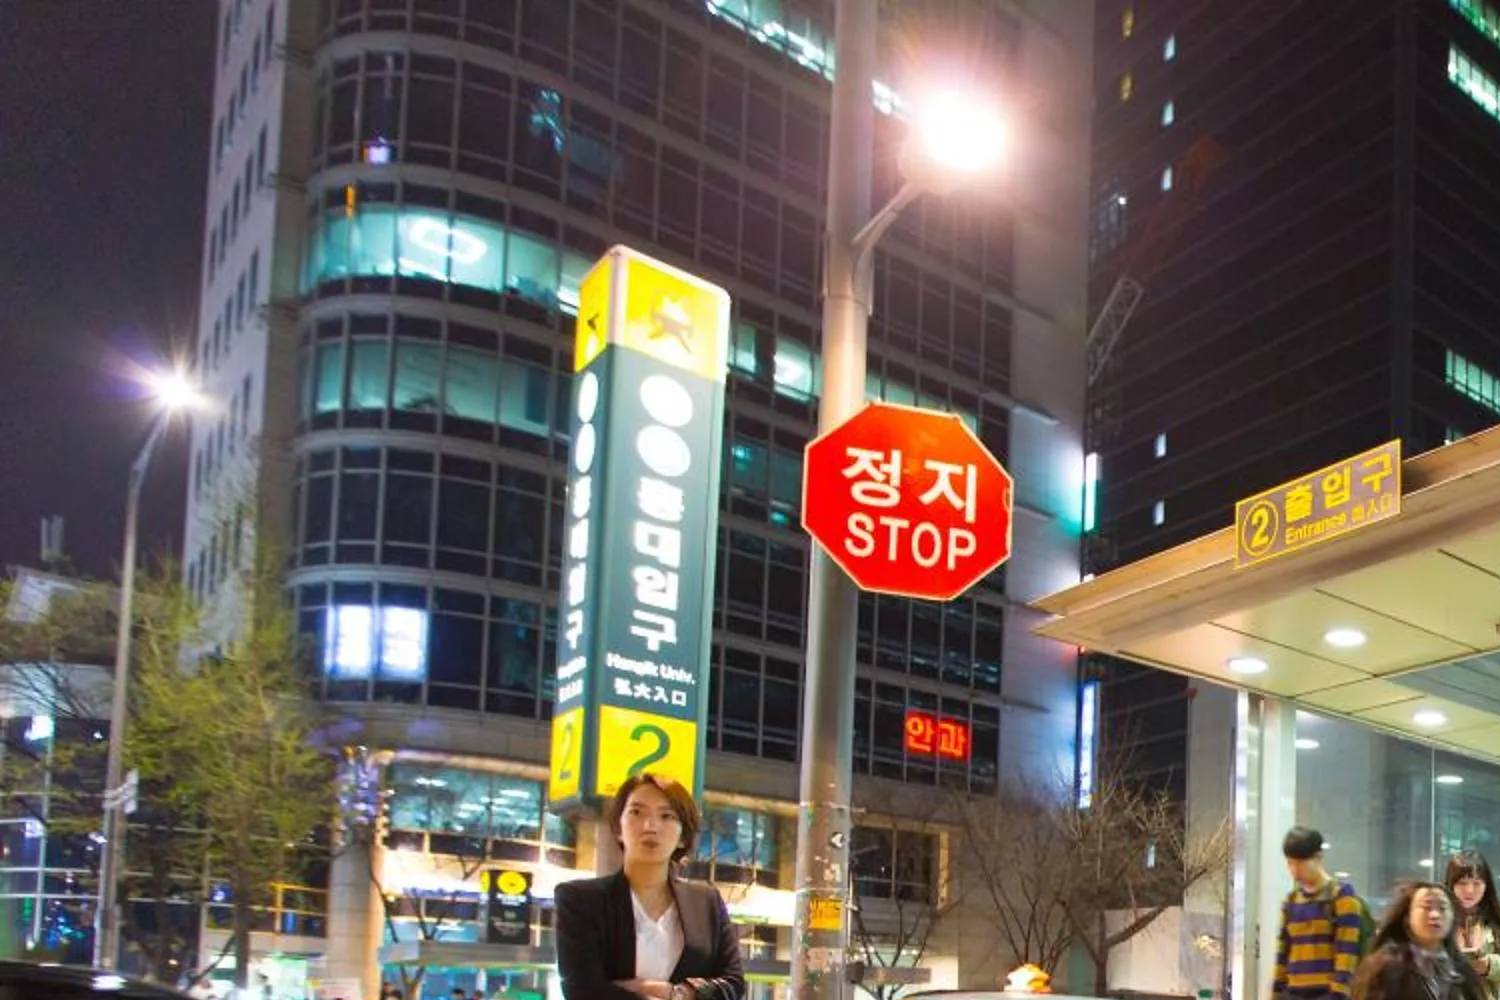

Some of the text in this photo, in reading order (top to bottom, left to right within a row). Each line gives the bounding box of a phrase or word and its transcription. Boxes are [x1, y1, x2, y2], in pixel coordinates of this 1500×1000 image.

[841, 446, 979, 524] 정지
[1284, 453, 1393, 522] 출입구
[844, 511, 978, 571] STOP
[1284, 512, 1347, 545] Entrance
[627, 723, 671, 778] 2
[904, 716, 966, 757] 안과
